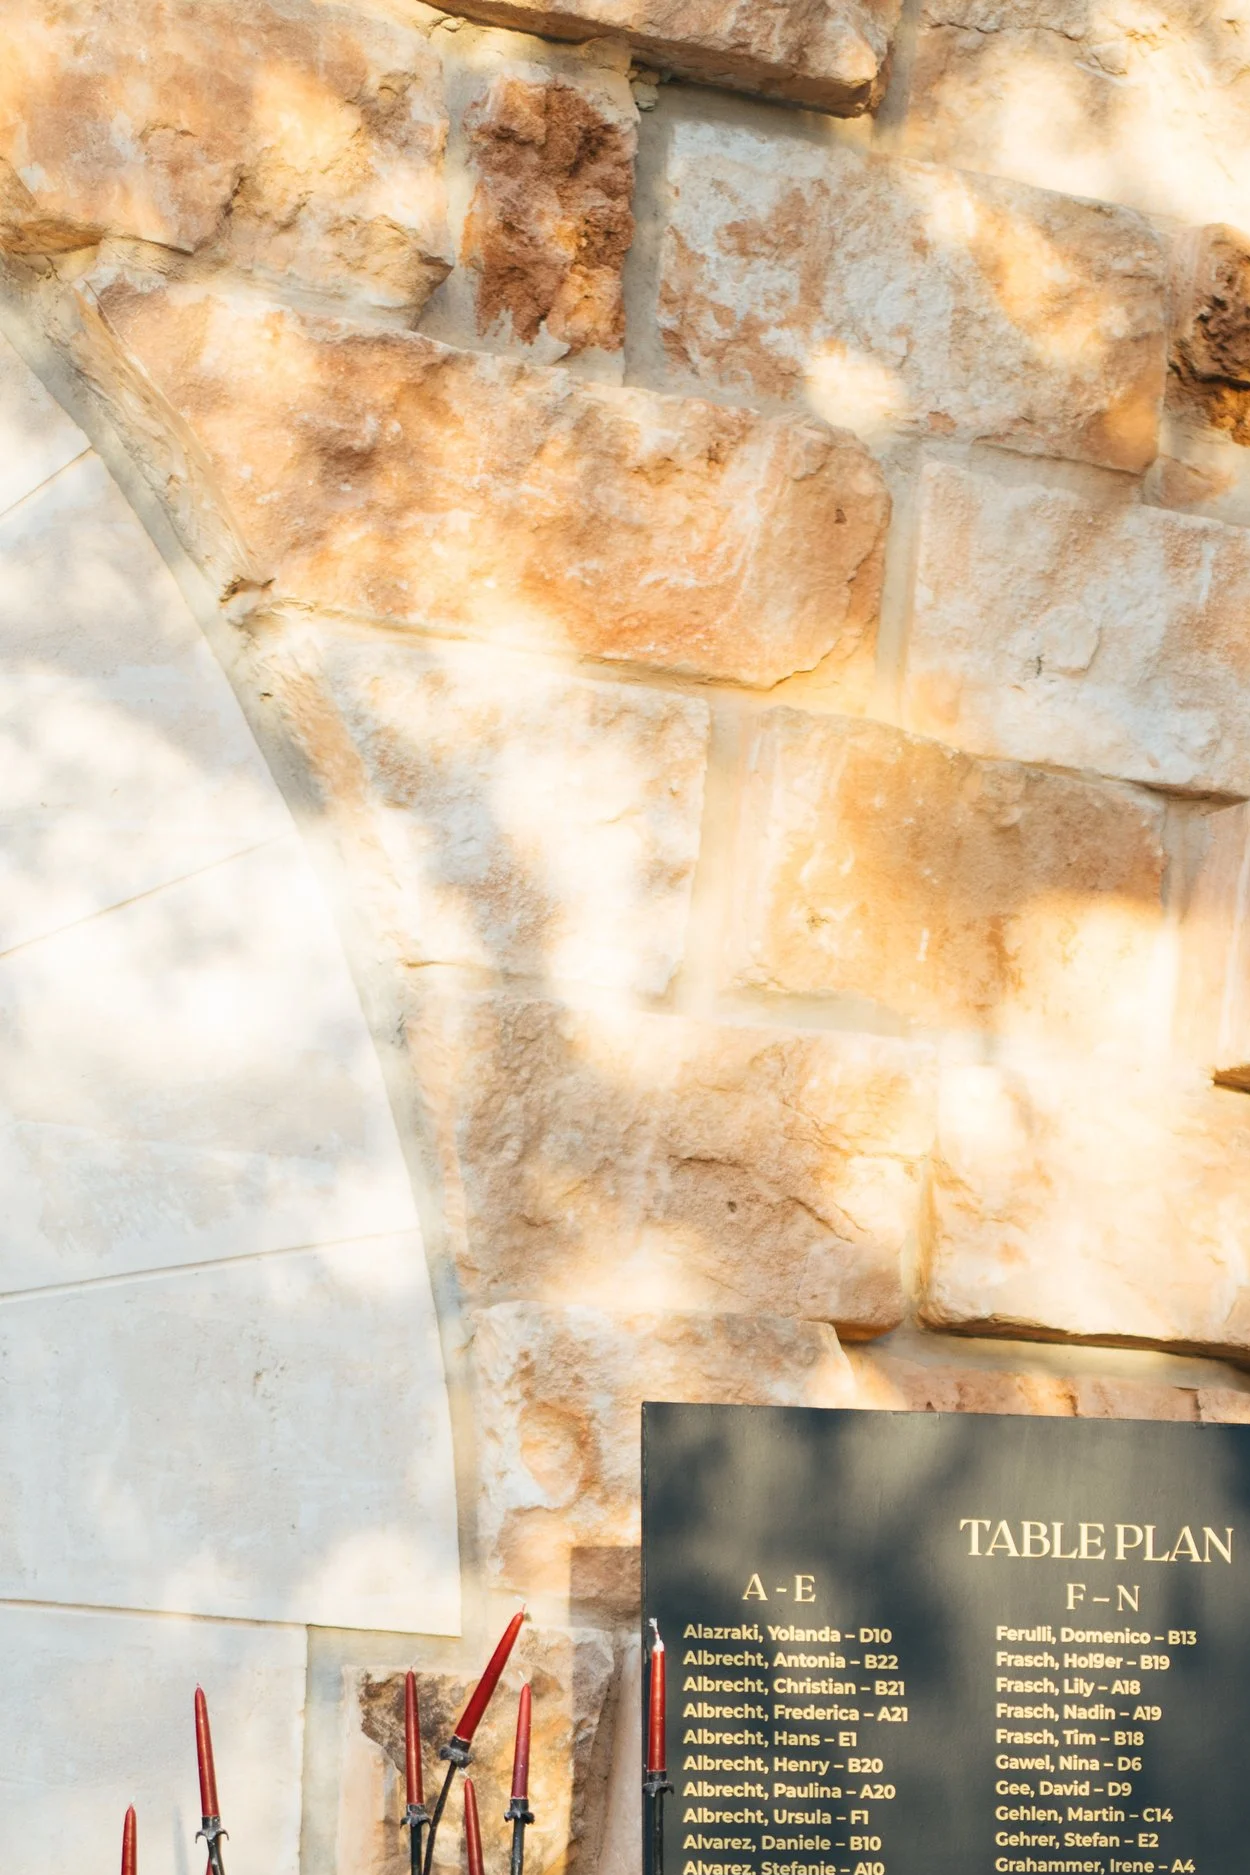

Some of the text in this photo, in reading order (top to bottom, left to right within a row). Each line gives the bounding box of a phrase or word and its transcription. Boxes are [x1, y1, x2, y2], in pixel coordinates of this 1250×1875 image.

[959, 1518, 1234, 1564] TABLE PLAN
[742, 1573, 768, 1601] A
[794, 1574, 816, 1603] E
[1066, 1583, 1086, 1610] F
[1116, 1584, 1140, 1612] N
[683, 1728, 769, 1748] Albrecht,
[774, 1730, 821, 1746] Hans
[839, 1731, 857, 1747] E1
[683, 1755, 769, 1774] Albrecht,
[774, 1757, 830, 1776] Henry
[848, 1758, 884, 1773] B20
[995, 1754, 1055, 1773] Gawel,
[1059, 1754, 1100, 1771] Nina
[1117, 1756, 1142, 1771] D6
[995, 1805, 1063, 1824] Gehlen,
[1067, 1806, 1125, 1822] Martin
[1142, 1808, 1174, 1823] C14
[995, 1857, 1105, 1875] Grahammer,
[1110, 1858, 1154, 1873] Irene
[1171, 1859, 1196, 1873] A4
